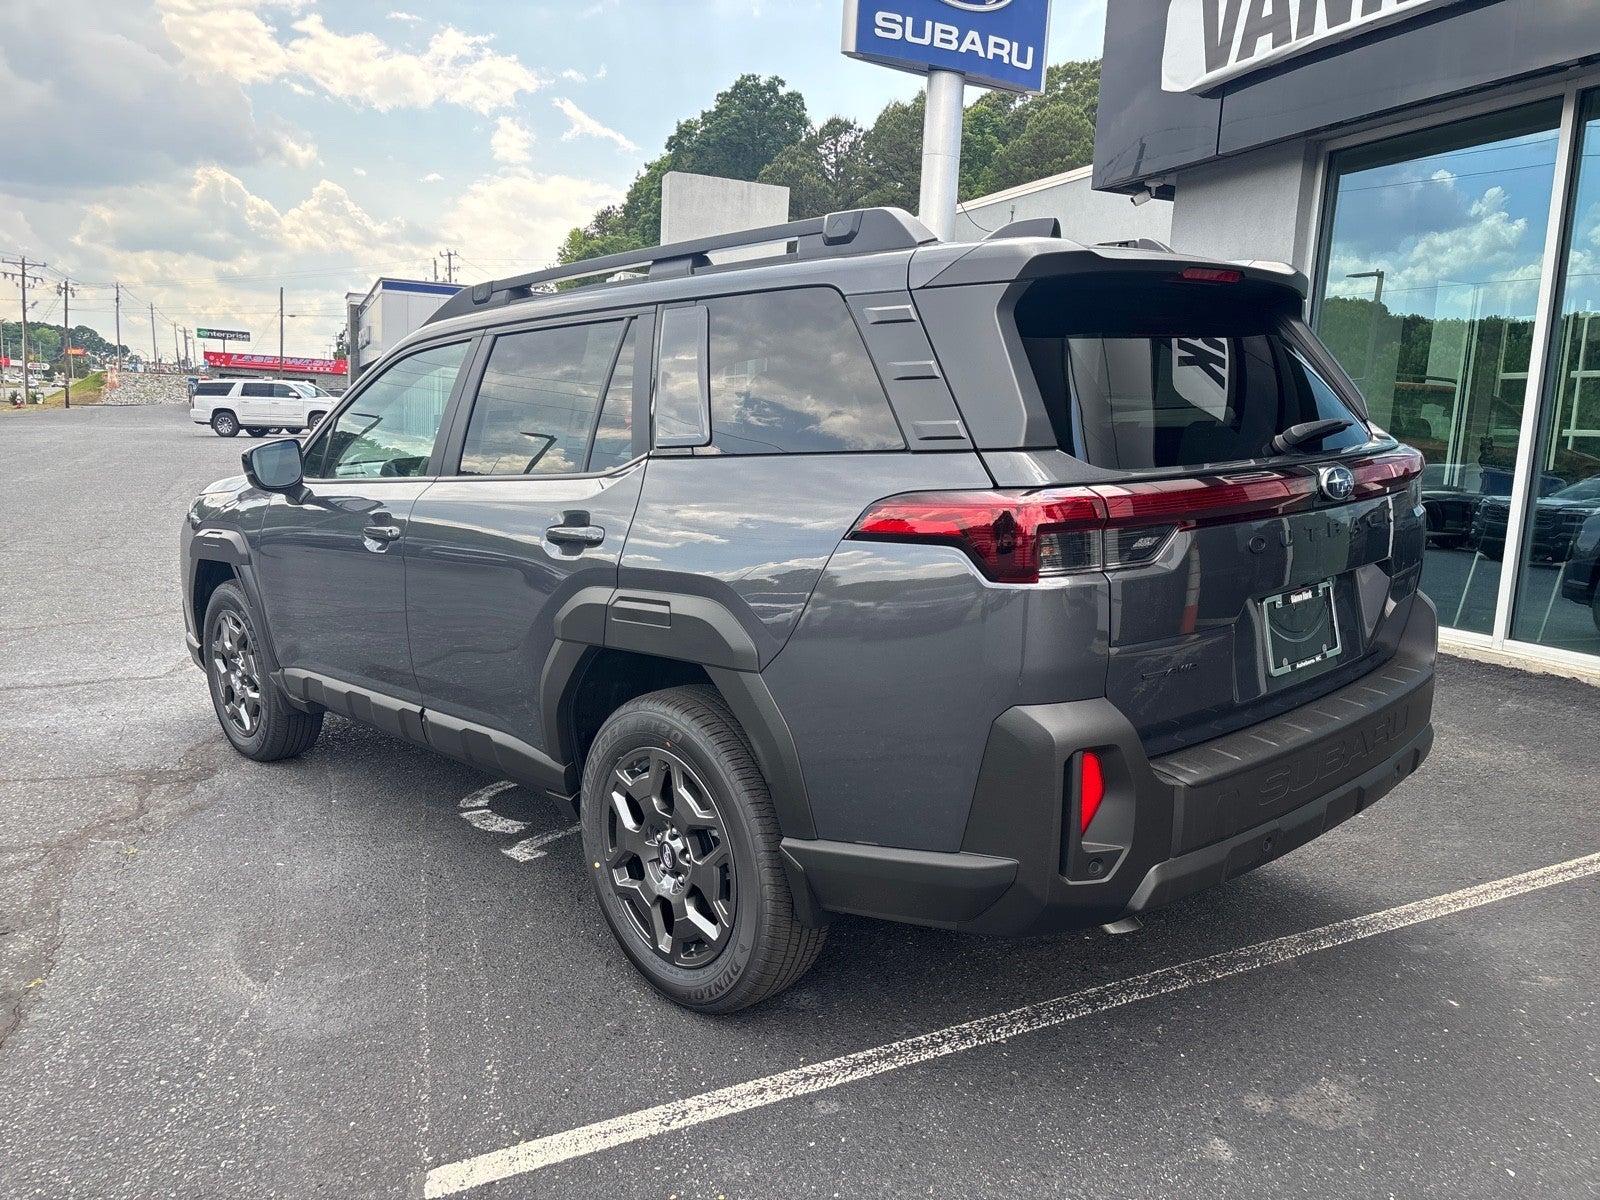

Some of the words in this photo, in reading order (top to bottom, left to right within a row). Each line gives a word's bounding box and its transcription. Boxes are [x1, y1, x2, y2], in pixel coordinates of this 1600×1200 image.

[874, 11, 1034, 71] SUBARU
[199, 330, 249, 339] enterprise
[231, 354, 336, 367] LASERWASH
[1259, 704, 1409, 806] SUBARU
